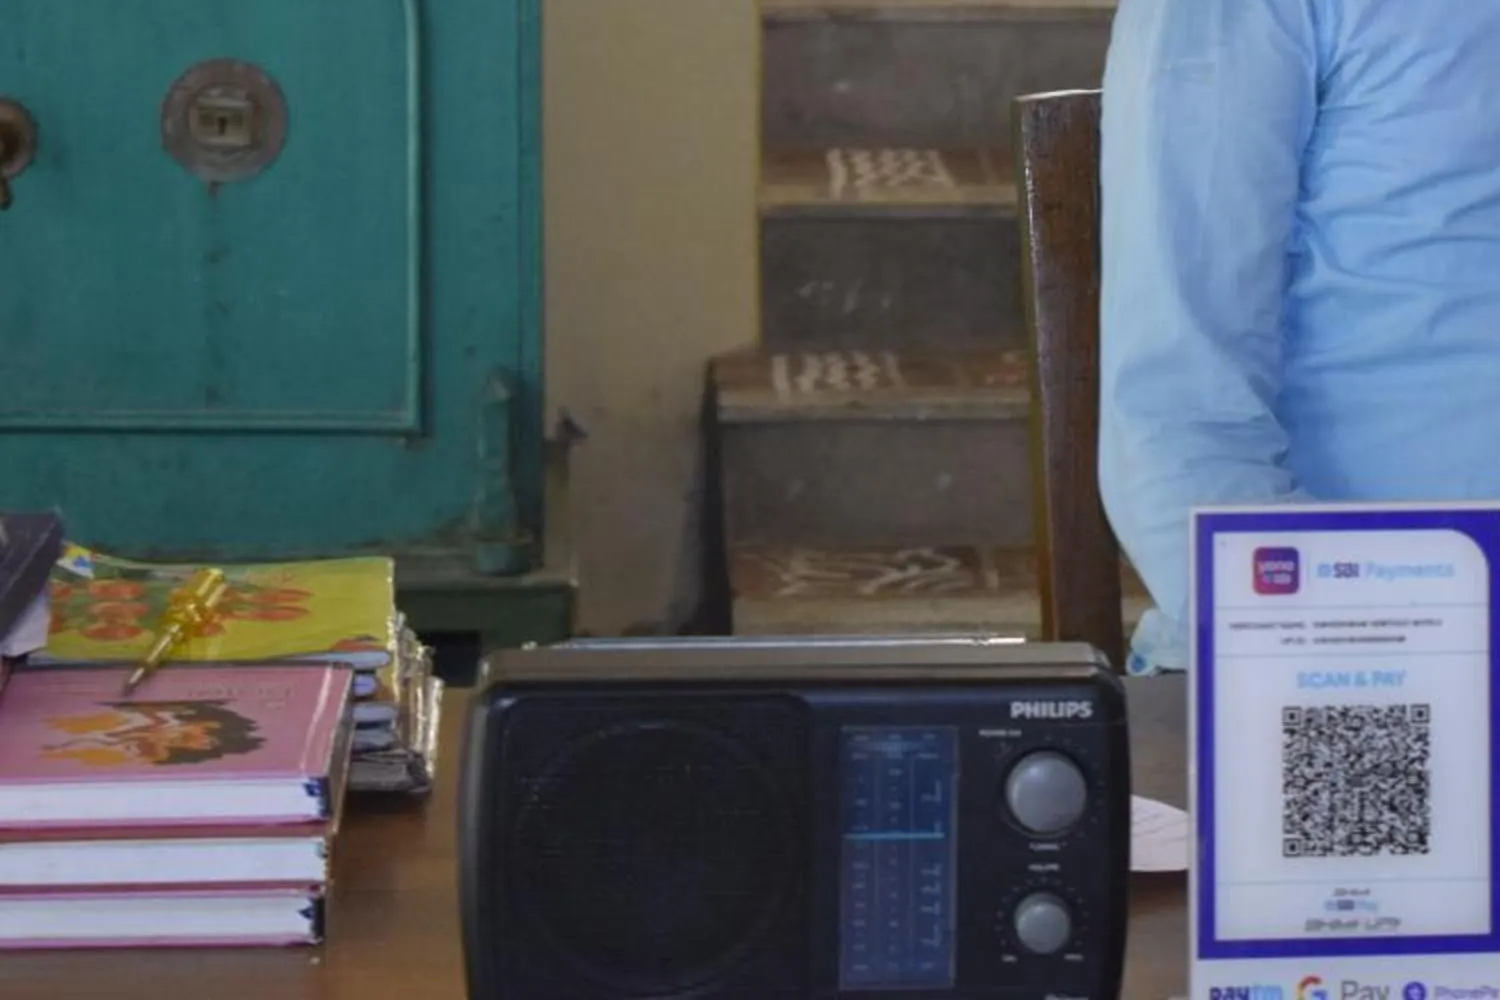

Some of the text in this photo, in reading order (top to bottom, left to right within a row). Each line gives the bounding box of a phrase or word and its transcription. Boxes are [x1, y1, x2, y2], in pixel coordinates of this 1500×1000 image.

[1333, 561, 1454, 581] SBI Payments
[1297, 671, 1350, 688] SCAN
[1372, 669, 1406, 687] PAY
[1010, 701, 1094, 719] PHILIPS
